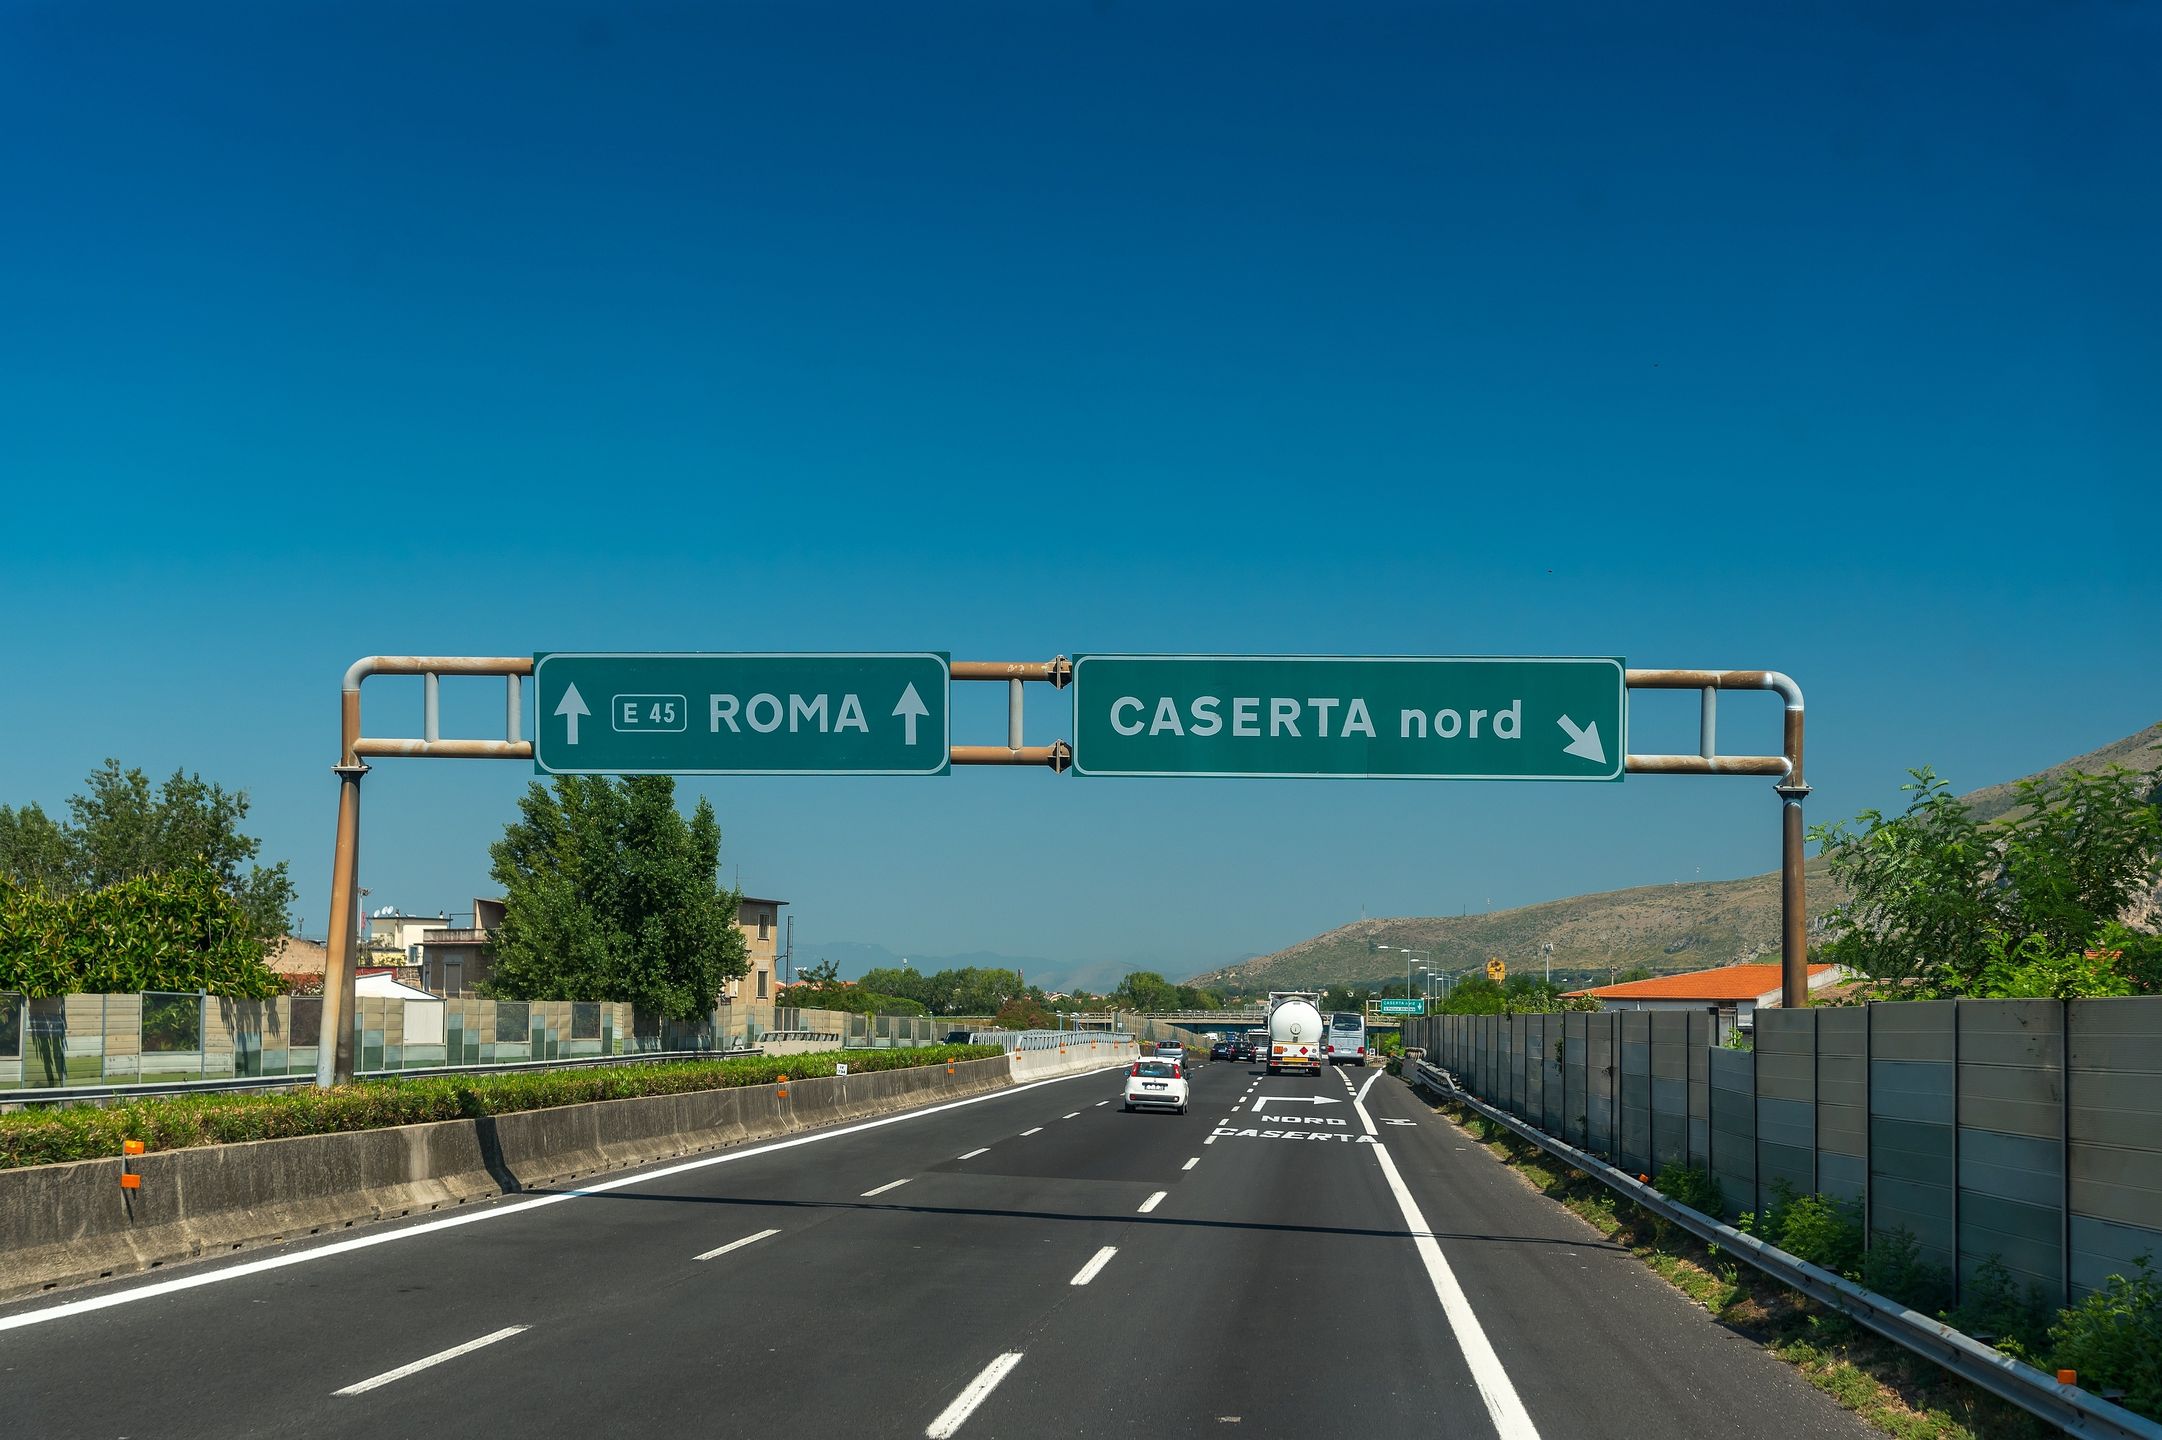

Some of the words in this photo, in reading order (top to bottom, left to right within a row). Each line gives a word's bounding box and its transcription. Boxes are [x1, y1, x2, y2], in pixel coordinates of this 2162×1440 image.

[624, 703, 638, 723] E
[650, 703, 675, 723] 45
[710, 693, 869, 733] ROMA
[1110, 695, 1377, 738] CASERTA
[1400, 699, 1522, 740] nord
[1261, 1115, 1347, 1125] NORD
[1212, 1127, 1378, 1143] CASERTA
